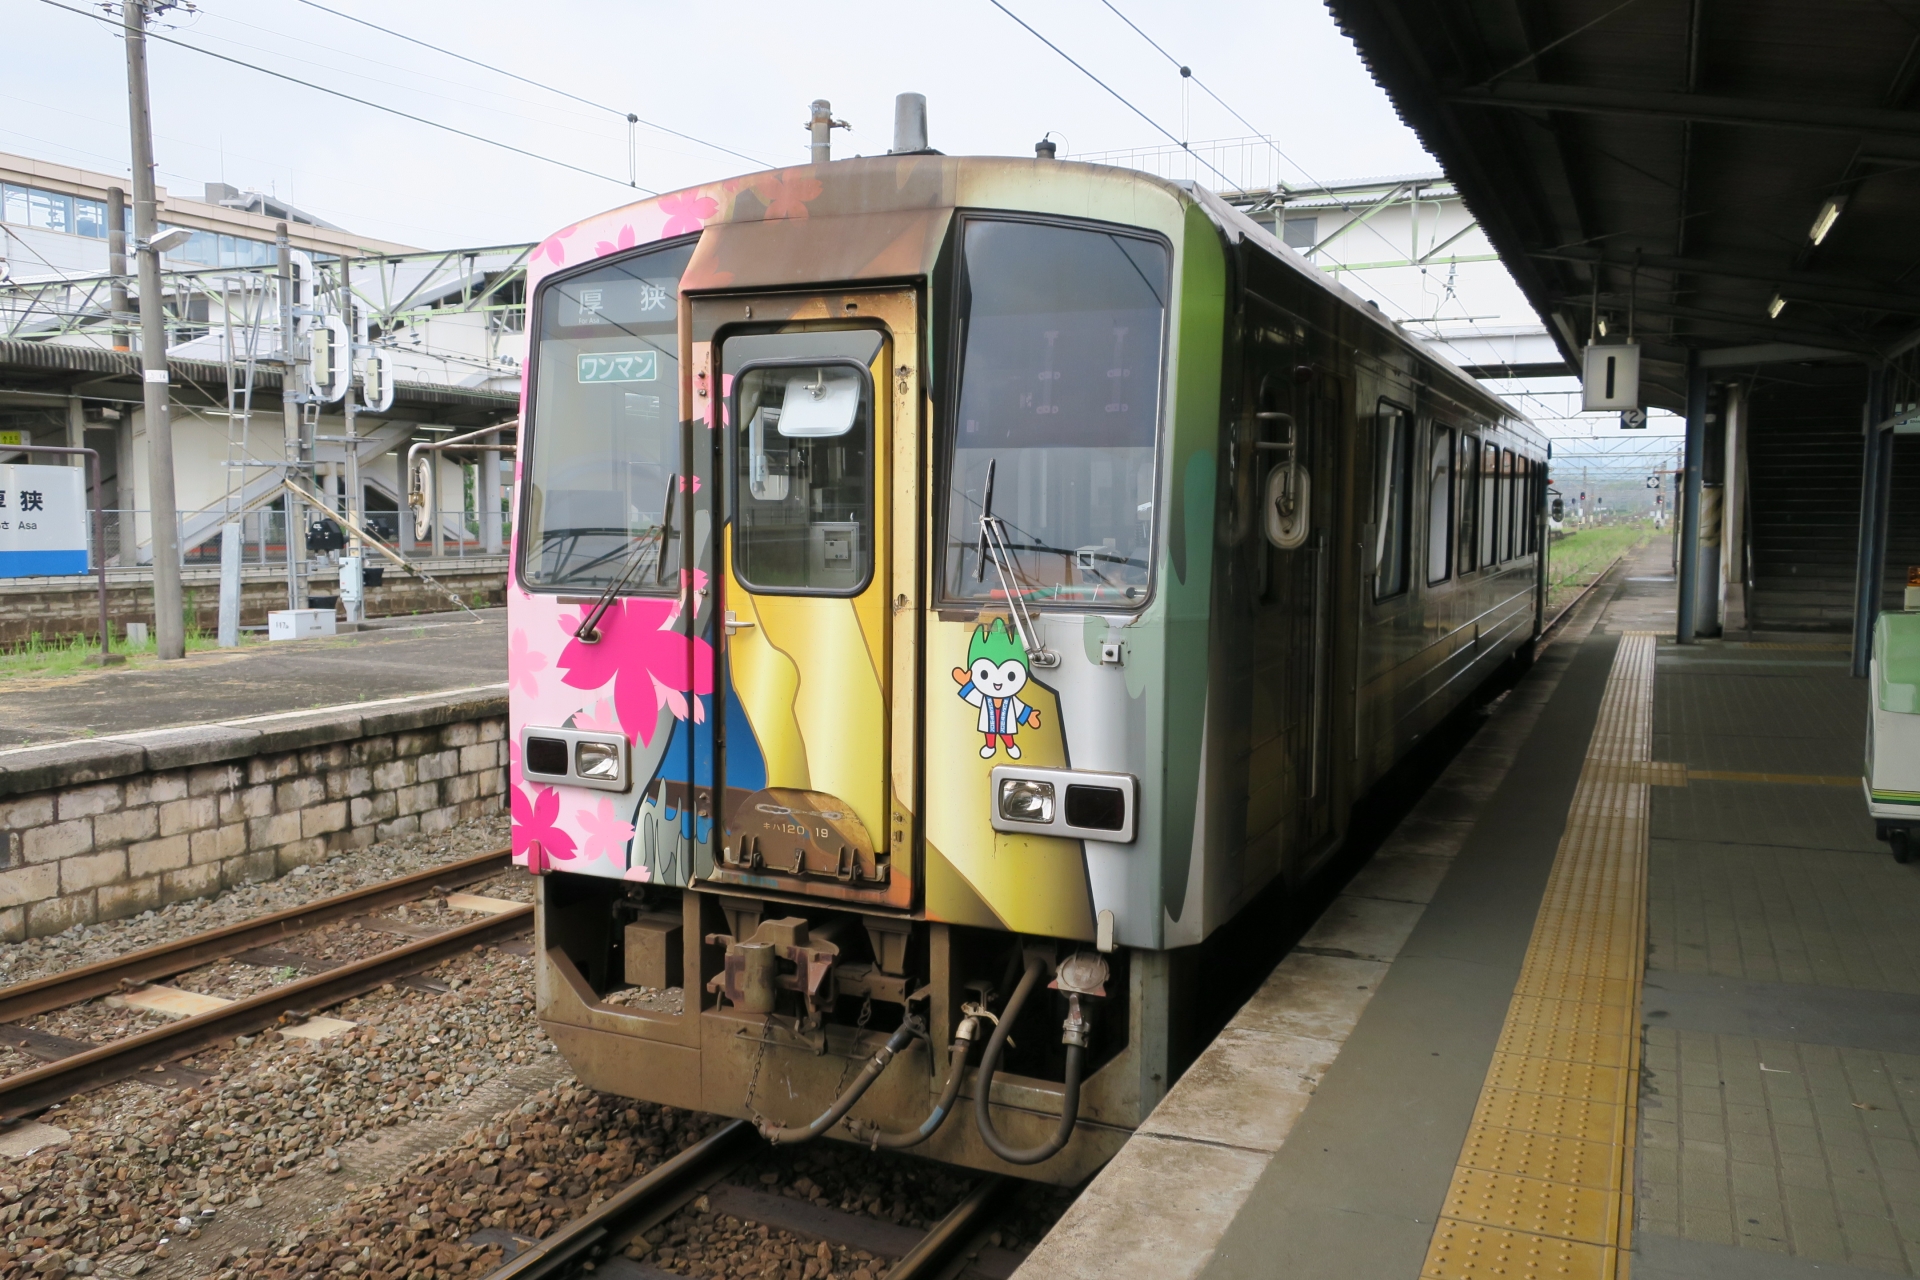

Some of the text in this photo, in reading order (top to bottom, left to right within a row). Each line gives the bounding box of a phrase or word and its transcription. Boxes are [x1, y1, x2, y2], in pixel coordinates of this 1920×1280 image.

[578, 284, 666, 315] 厚狭
[578, 317, 600, 325] For Asa
[581, 356, 653, 380] ワンマン
[1628, 410, 1639, 424] 2
[18, 520, 37, 530] Asa
[815, 827, 829, 838] 19
